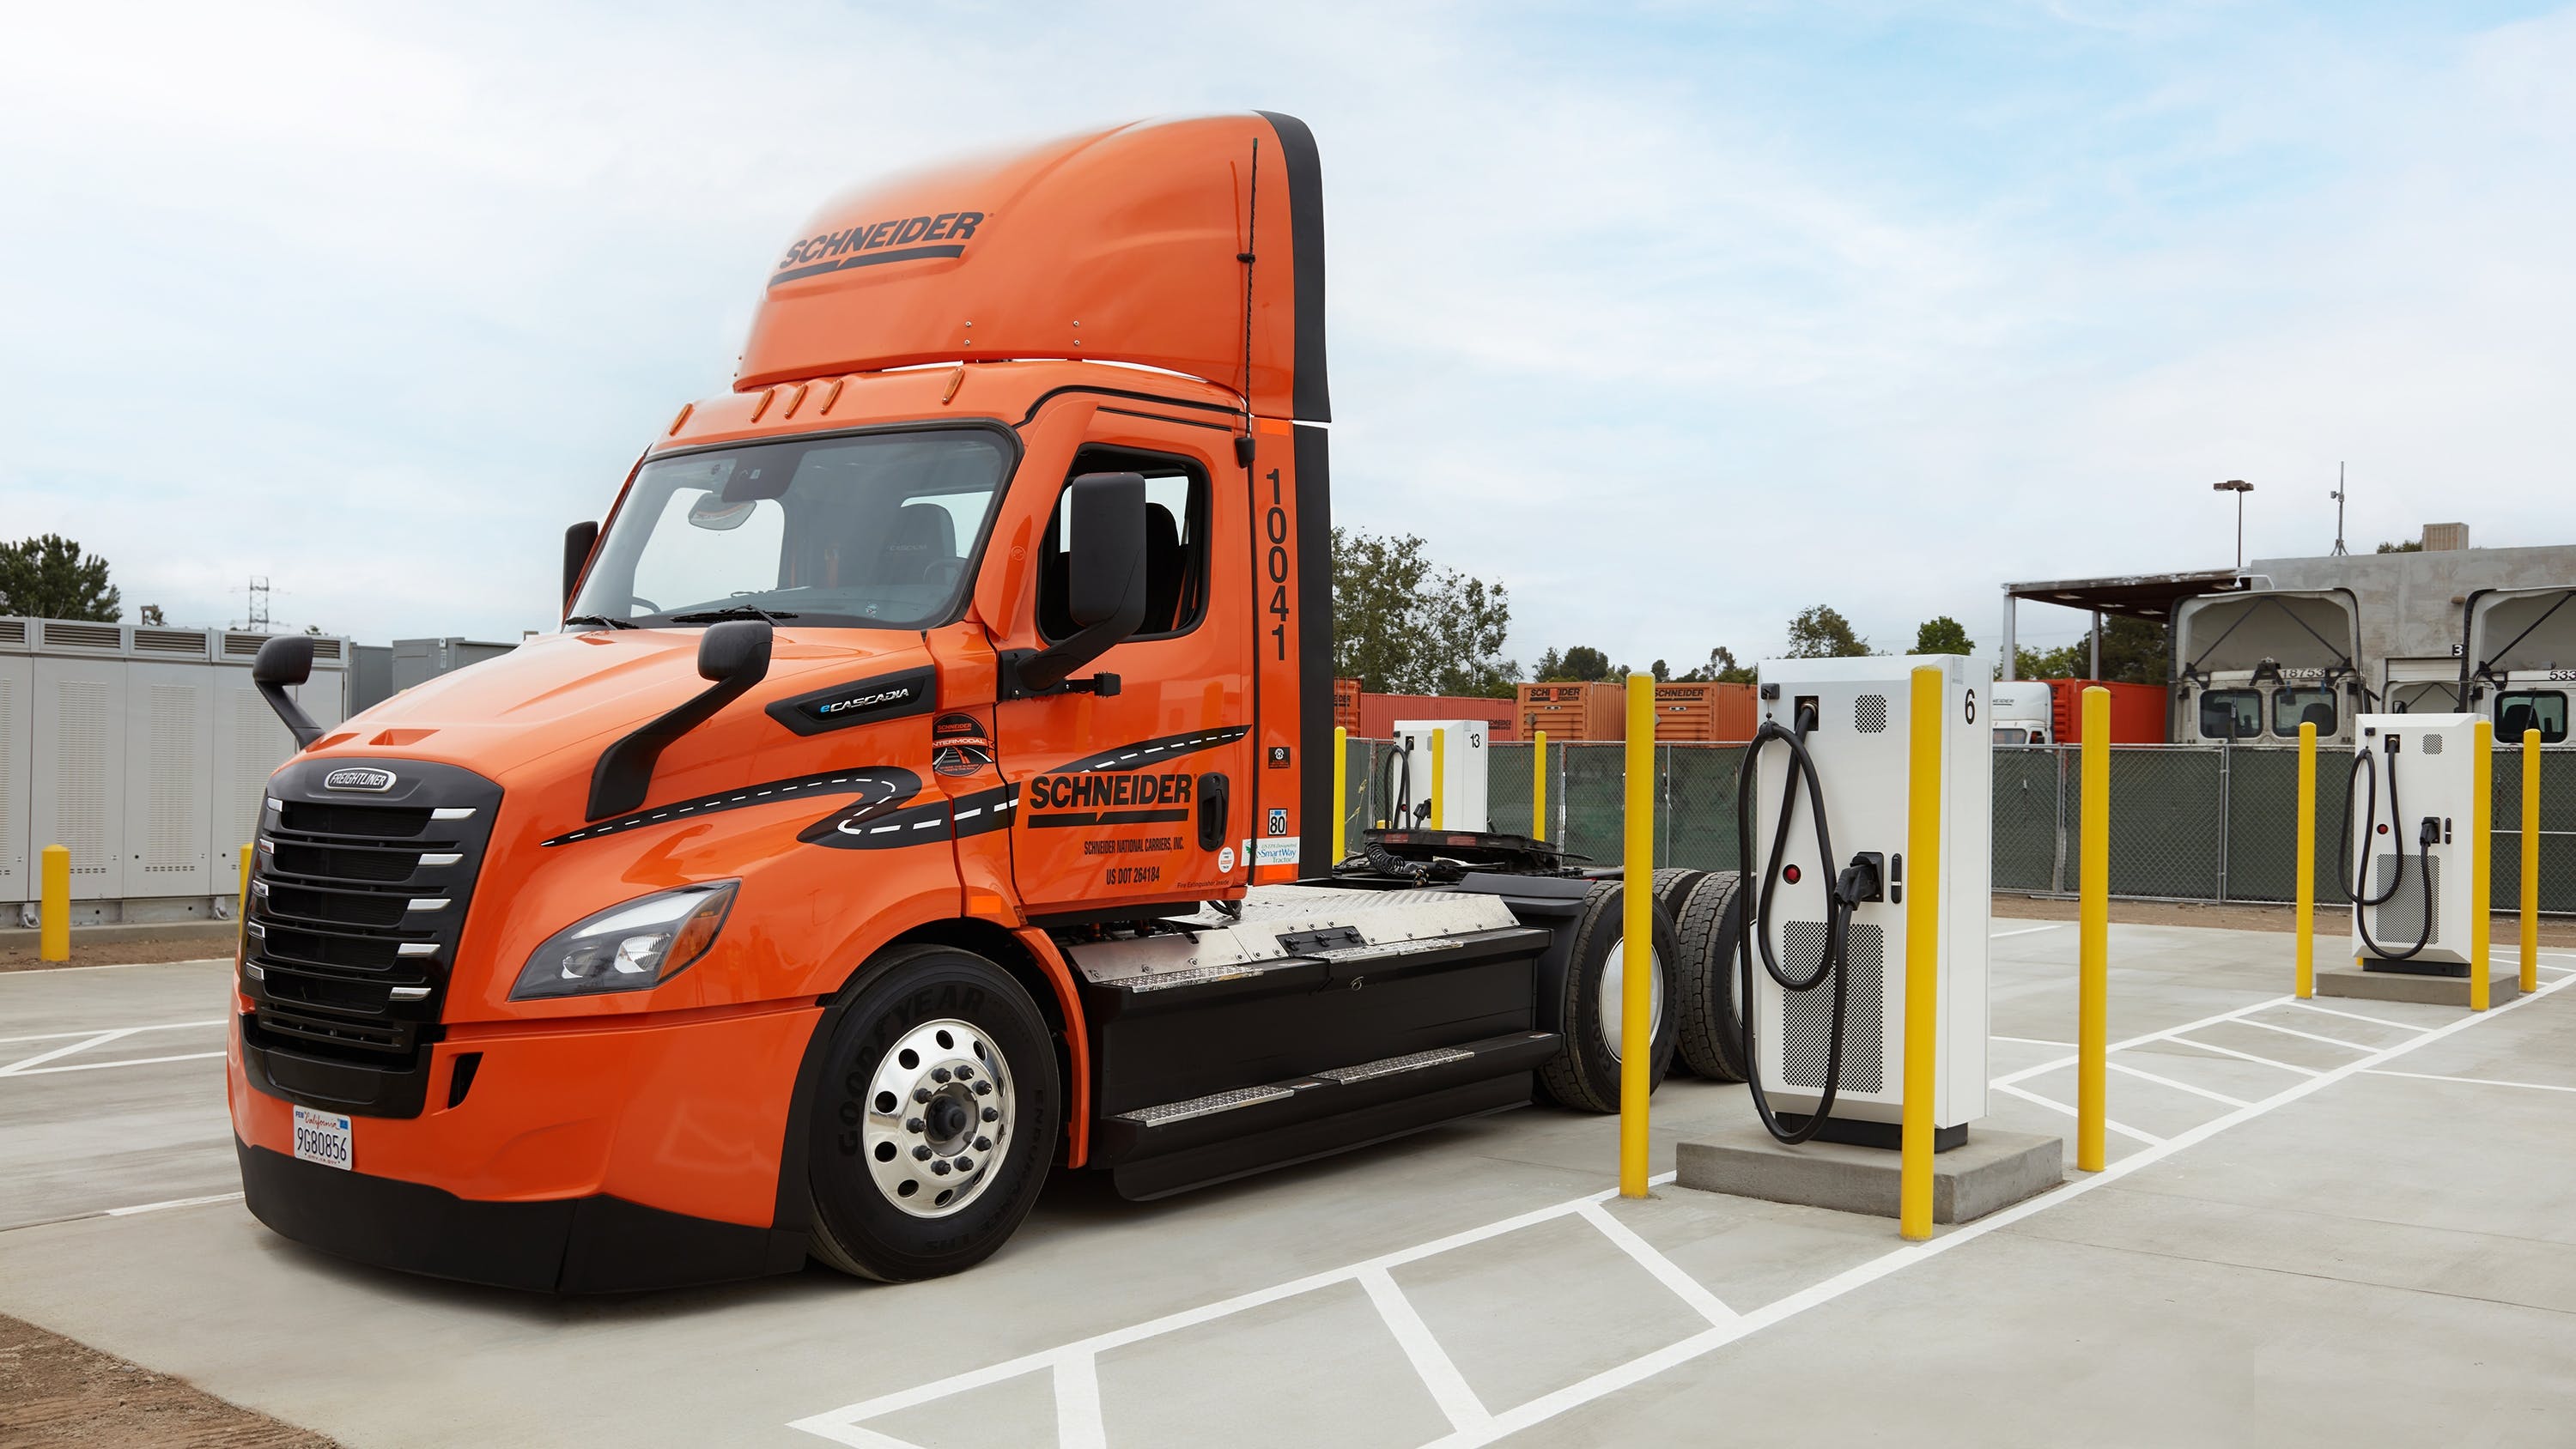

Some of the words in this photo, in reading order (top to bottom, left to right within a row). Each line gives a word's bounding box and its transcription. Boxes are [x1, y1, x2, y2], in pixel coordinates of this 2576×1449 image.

[779, 212, 985, 269] SCHNEIDER
[1266, 468, 1289, 661] 10041
[2281, 669, 2324, 678] 18753
[820, 688, 909, 712] eCASCADIA
[1530, 688, 1581, 697] SCHIDER
[1965, 688, 1976, 724] 6
[933, 737, 985, 747] NTERMODAL
[1470, 733, 1480, 749] 13
[329, 772, 388, 786] FREIGHTLINER
[1030, 774, 1193, 809] SCHNEIDER
[1270, 815, 1285, 834] 80
[1084, 840, 1115, 855] SCHNEIDER
[1116, 839, 1143, 853] NATIONAL
[1145, 837, 1172, 852] CARRIERS,
[1173, 836, 1184, 851] INC.
[1261, 848, 1297, 858] SmartWay
[1106, 869, 1115, 885] US
[1118, 868, 1132, 883] DOT
[1133, 866, 1160, 882] 264184
[1187, 880, 1215, 889] Extinguisher
[304, 1111, 340, 1130] California
[297, 1126, 347, 1161] 9G80856
